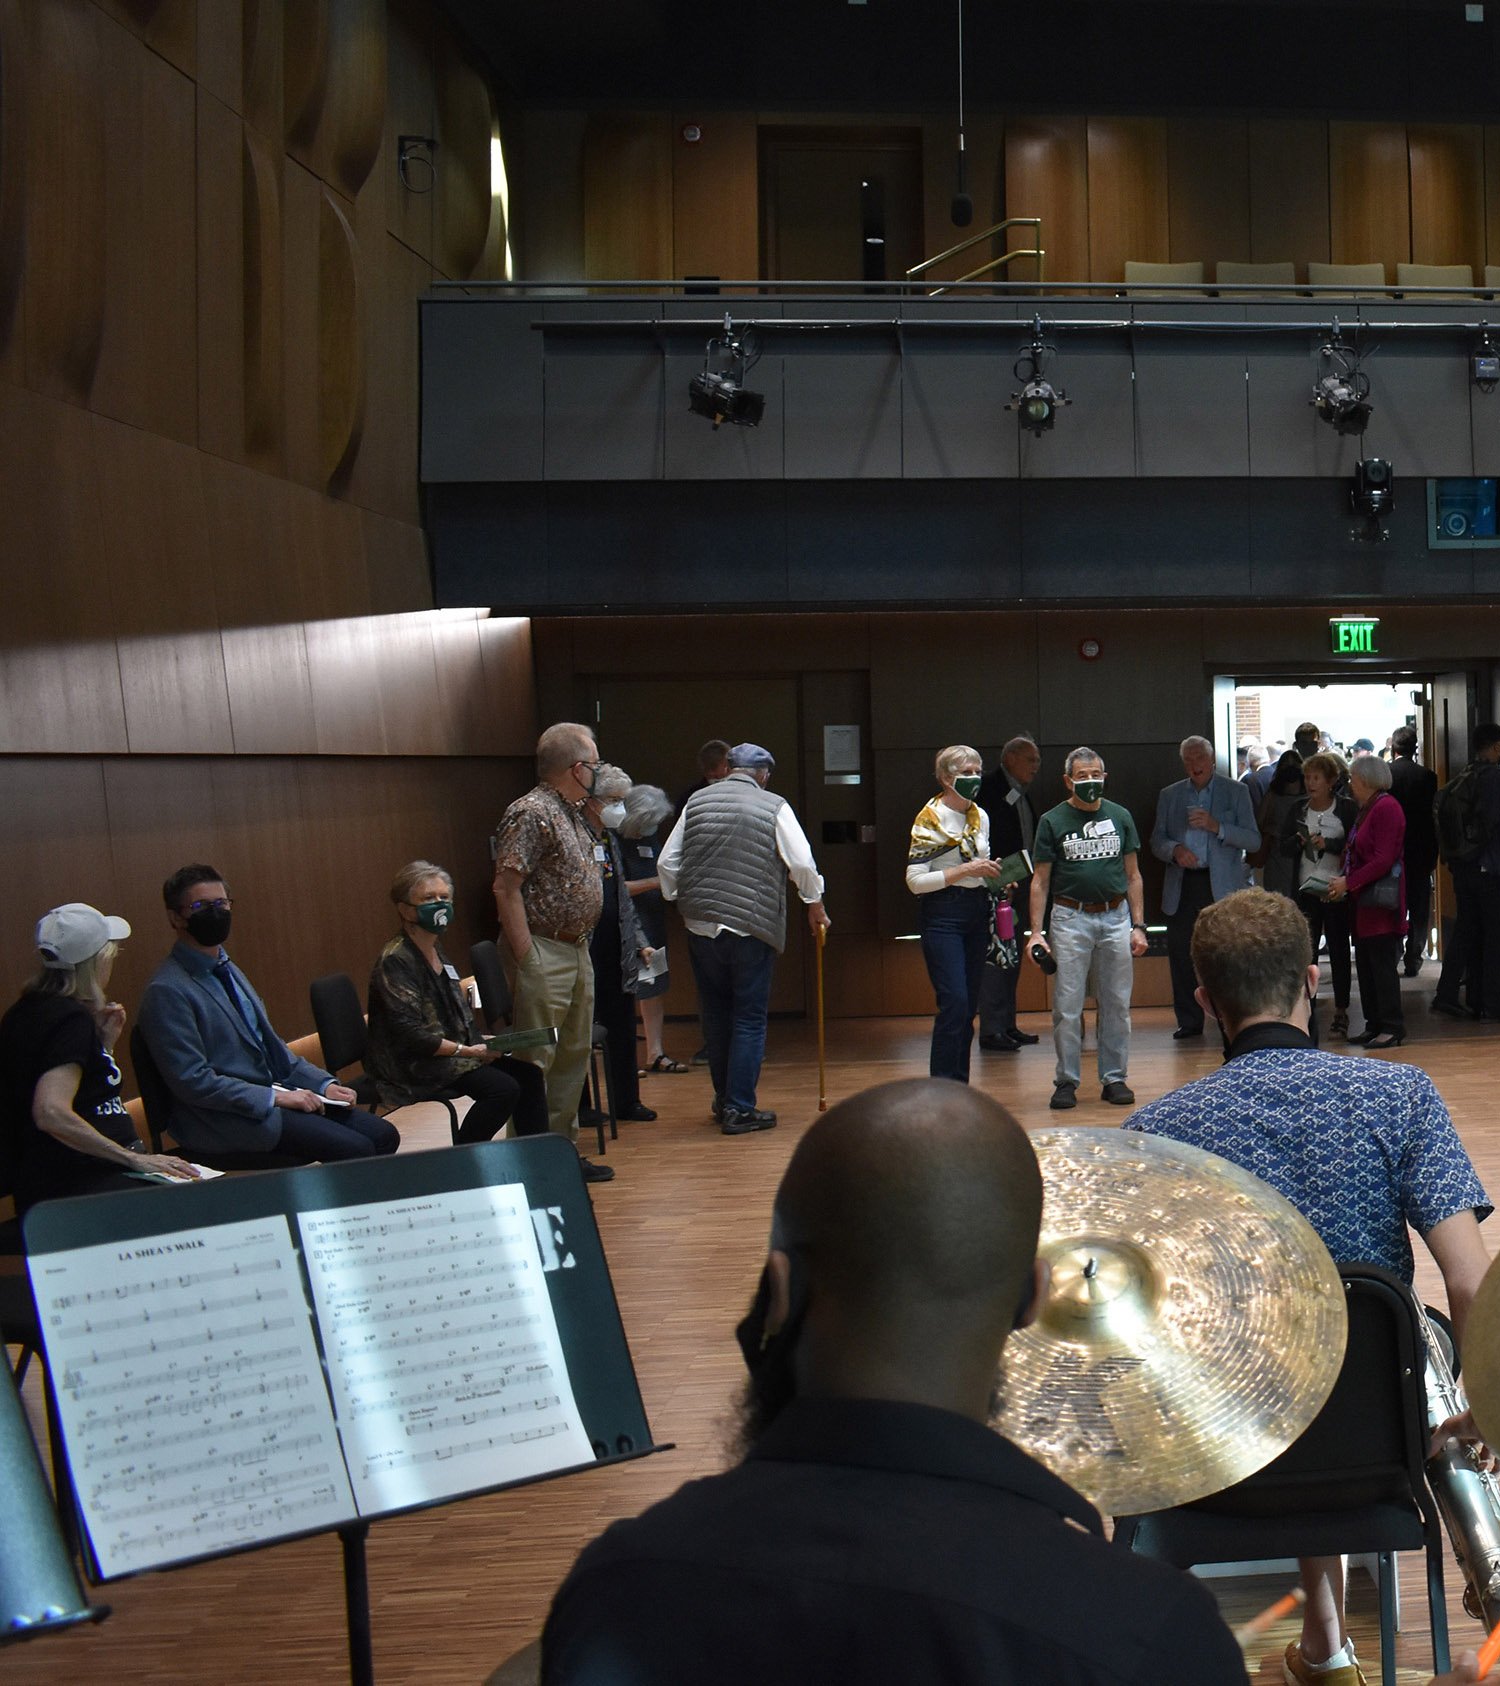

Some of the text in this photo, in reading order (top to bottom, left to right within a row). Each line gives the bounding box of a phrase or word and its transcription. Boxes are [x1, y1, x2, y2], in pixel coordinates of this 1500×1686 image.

[1339, 625, 1374, 651] EXIT
[1064, 837, 1121, 857] MICHIGAN STATE
[118, 1252, 133, 1261] LA
[134, 1245, 174, 1259] SHEA'S
[174, 1239, 206, 1252] WALK
